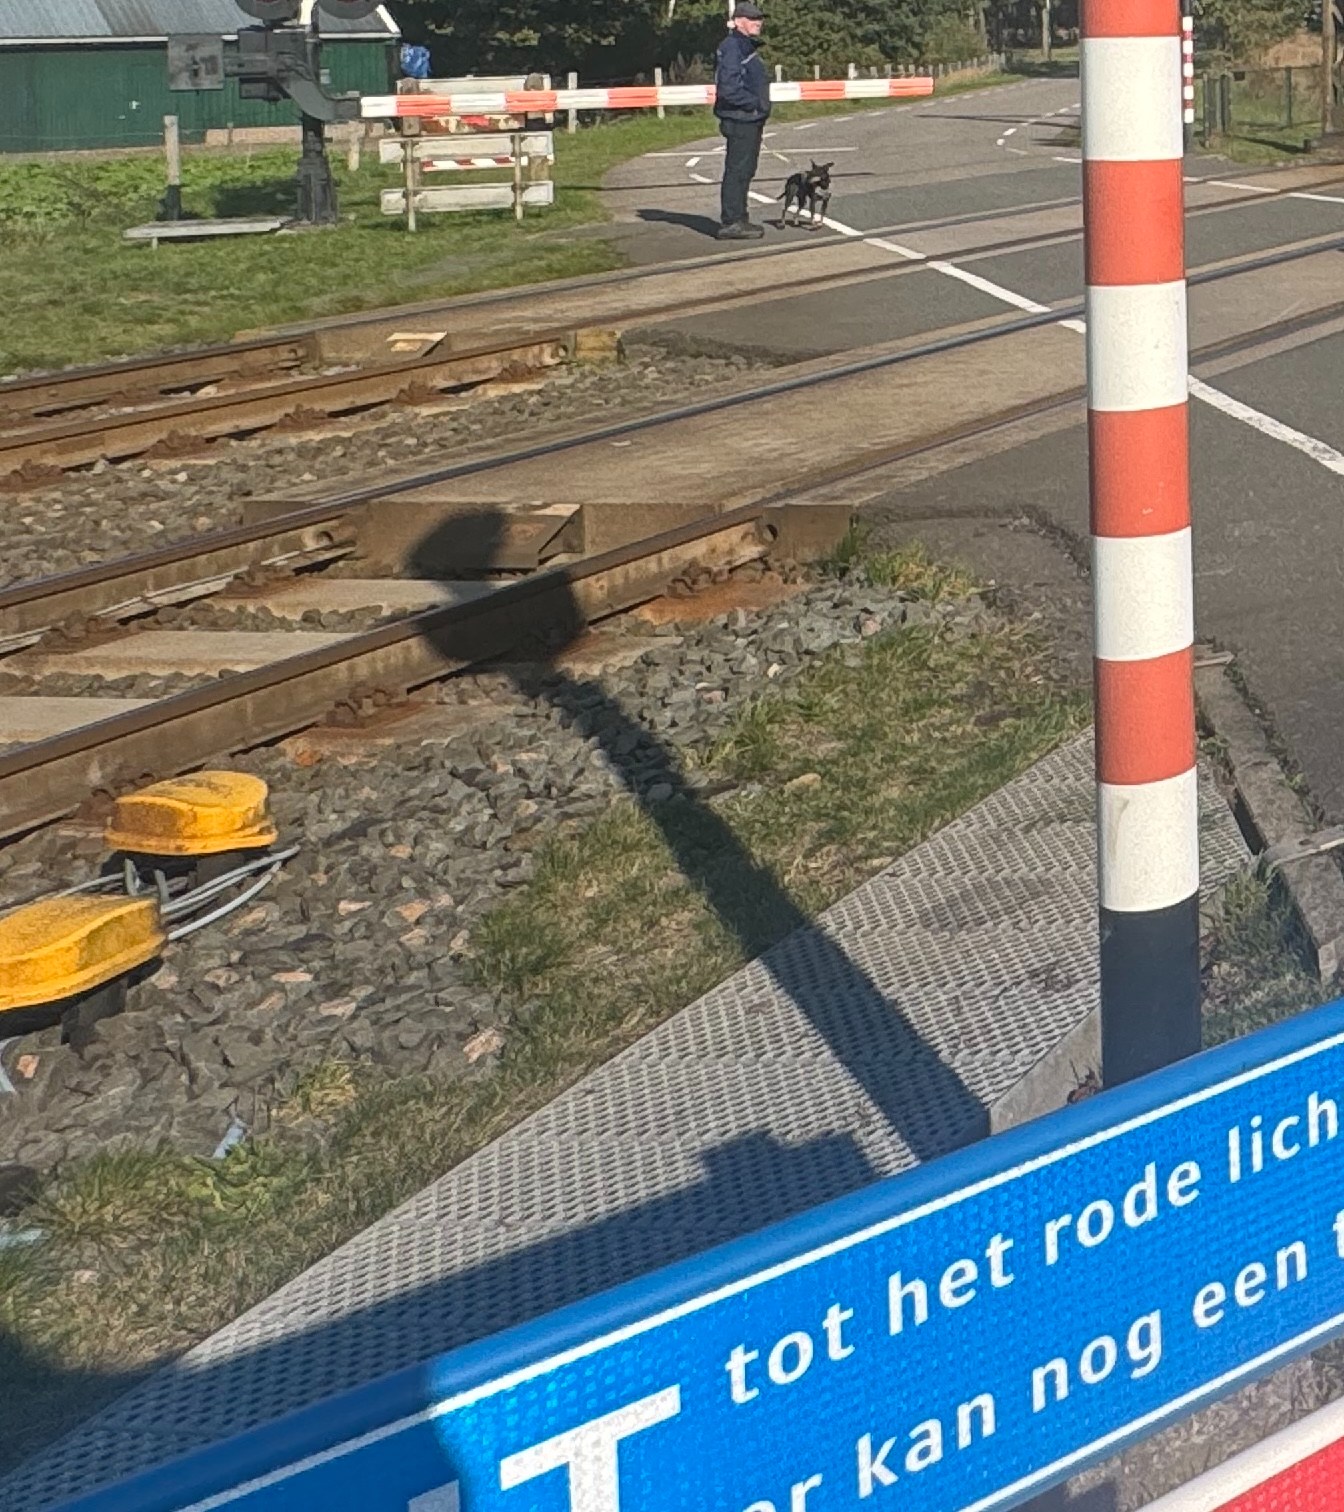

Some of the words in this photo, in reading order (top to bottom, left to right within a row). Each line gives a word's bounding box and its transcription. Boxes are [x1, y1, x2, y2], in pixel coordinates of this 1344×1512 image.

[724, 1302, 855, 1405] tot
[888, 1232, 1015, 1335] het
[1044, 1161, 1200, 1266] rode
[855, 1392, 996, 1499] kan
[1032, 1309, 1162, 1413] nog
[1192, 1240, 1308, 1328] een
